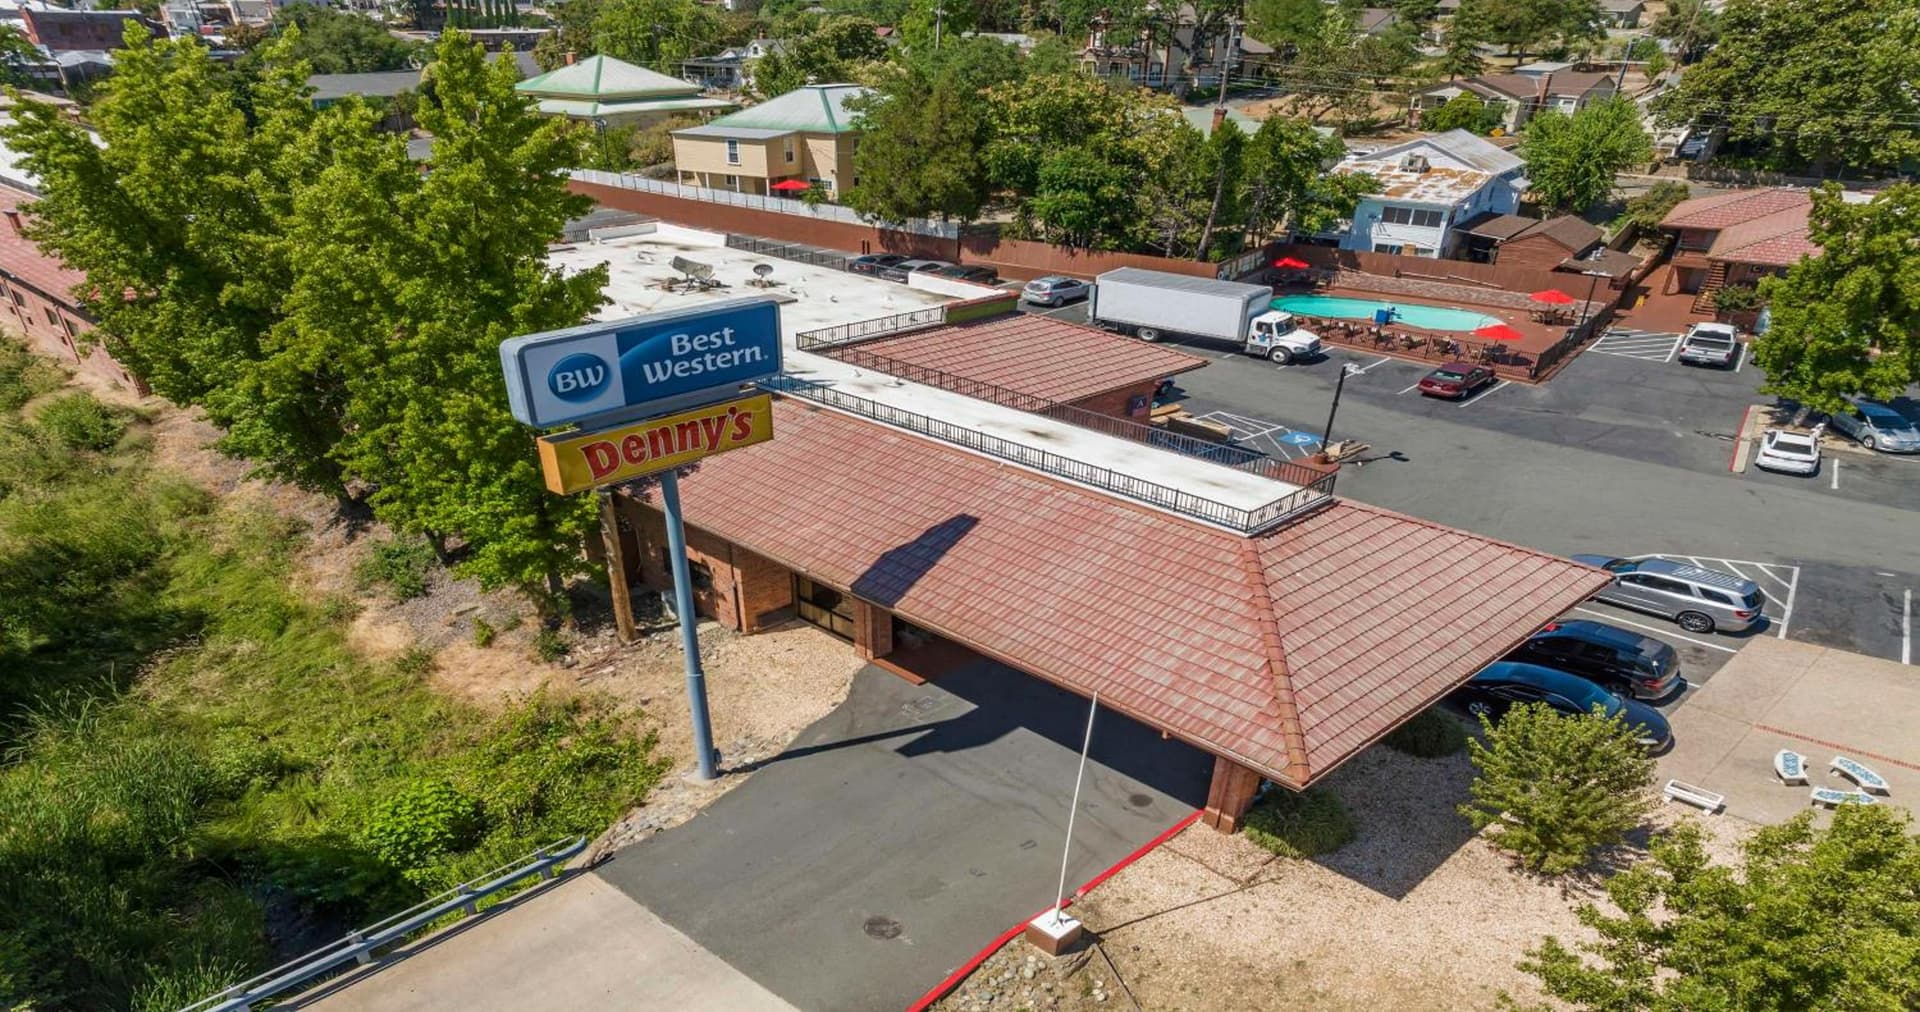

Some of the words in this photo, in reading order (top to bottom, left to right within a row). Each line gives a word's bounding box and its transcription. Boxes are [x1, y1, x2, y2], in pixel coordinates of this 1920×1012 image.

[671, 327, 736, 356] Best
[555, 364, 604, 393] BW
[580, 406, 753, 481] Denny's
